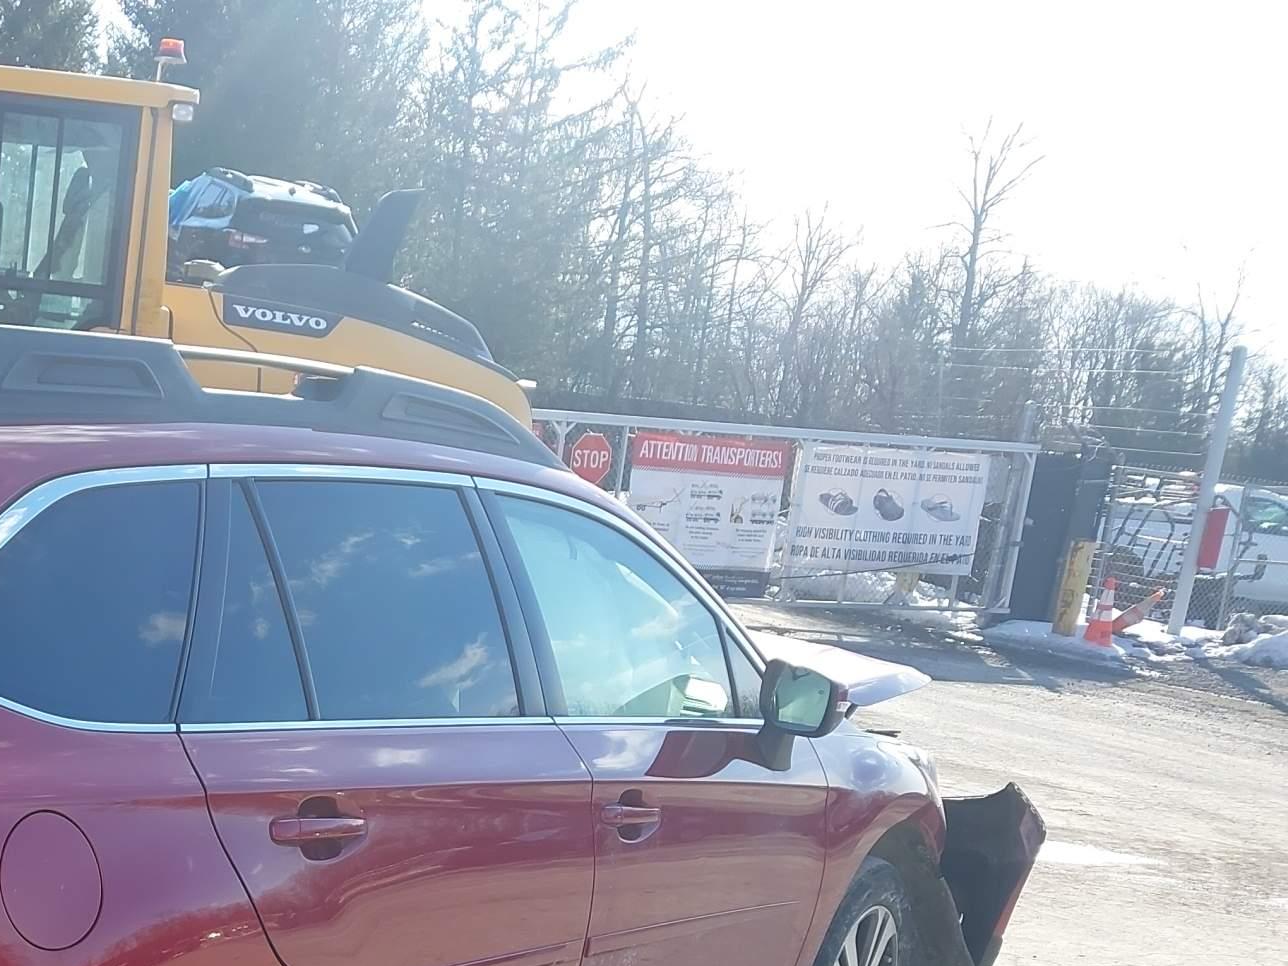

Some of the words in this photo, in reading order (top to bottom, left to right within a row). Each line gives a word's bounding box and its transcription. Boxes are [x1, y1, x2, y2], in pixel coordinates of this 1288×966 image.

[232, 304, 327, 330] VOLVO
[573, 449, 609, 469] STOP
[640, 439, 698, 463] ATTENTION
[701, 444, 782, 469] TRANSPORTERS!
[833, 454, 862, 464] FOOTWEAR
[899, 459, 909, 468] THE
[833, 467, 859, 477] CALZADO
[884, 470, 892, 480] EN
[893, 471, 900, 480] EL
[796, 526, 813, 538] HIGH
[814, 527, 854, 541] VISIBILITY
[854, 530, 890, 543] CLOTHING
[892, 532, 928, 545] REQUIRED
[928, 533, 937, 545] IN
[939, 534, 953, 546] THE
[790, 544, 808, 557] ROPA
[810, 546, 820, 558] DE
[821, 547, 841, 560] ALTA
[844, 549, 887, 562] VISIBILIDAD
[888, 550, 928, 564] REQUERIDA
